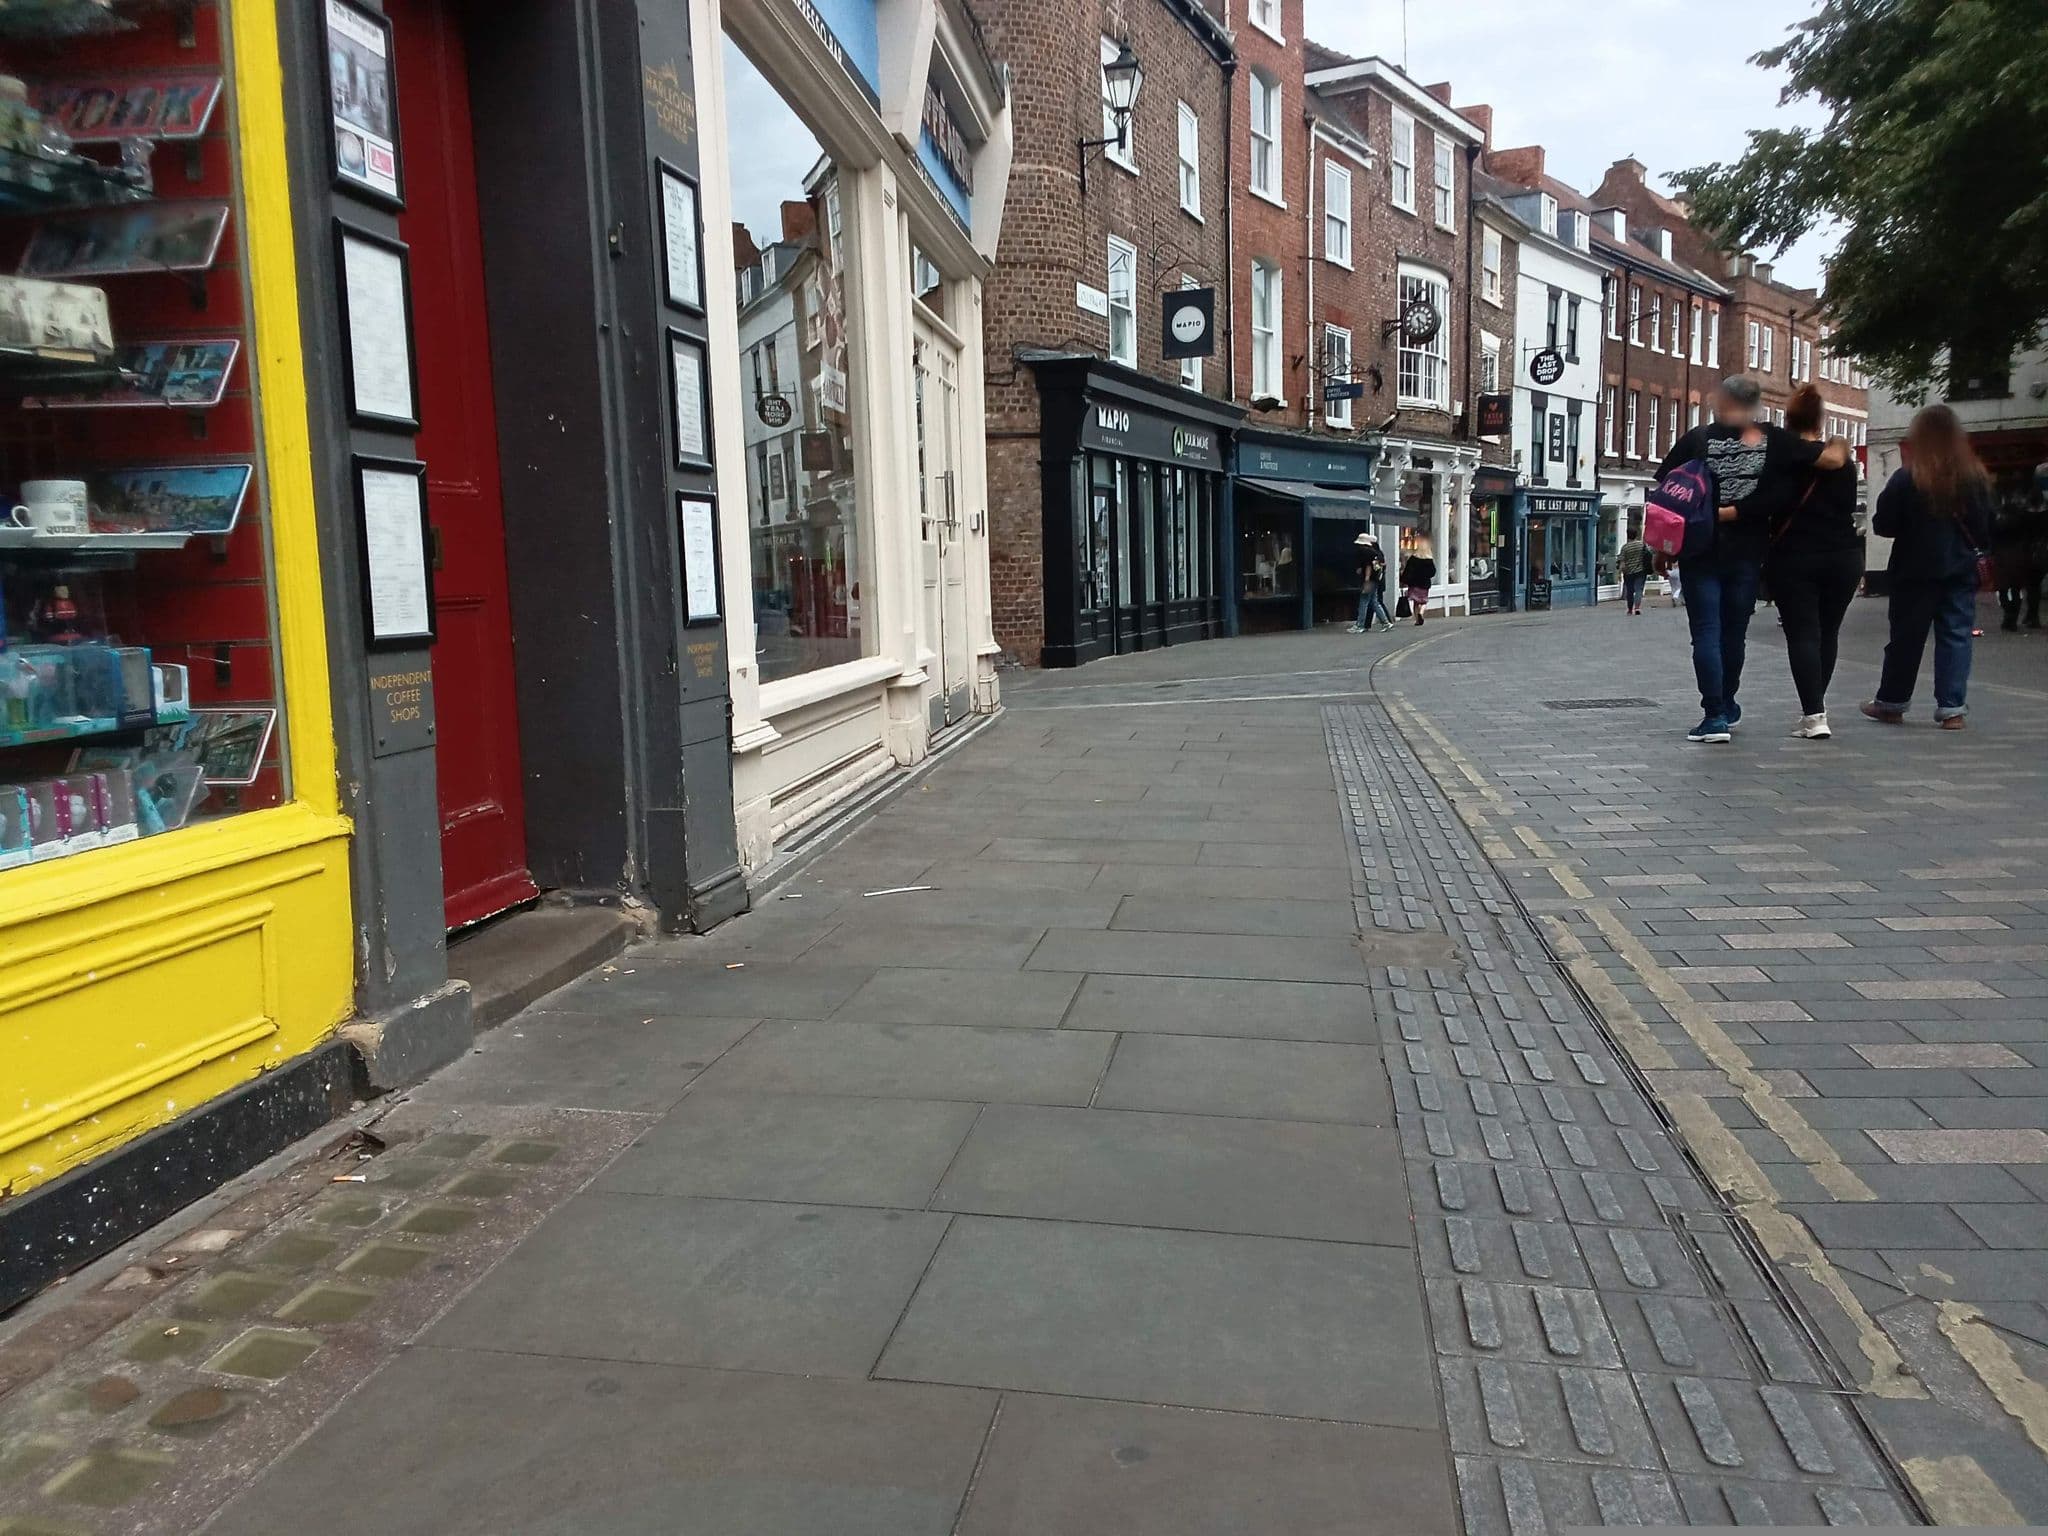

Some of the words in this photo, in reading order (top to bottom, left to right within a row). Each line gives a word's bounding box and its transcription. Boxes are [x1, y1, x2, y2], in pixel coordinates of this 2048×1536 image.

[1536, 367, 1558, 376] DROP
[1537, 360, 1557, 368] LAST
[1098, 406, 1129, 432] MAPIO
[1535, 500, 1546, 510] THE
[1548, 500, 1562, 510] LAST
[370, 670, 431, 689] INDEPENDENT
[386, 689, 421, 706] COFFEE
[391, 706, 420, 722] SHOPS
